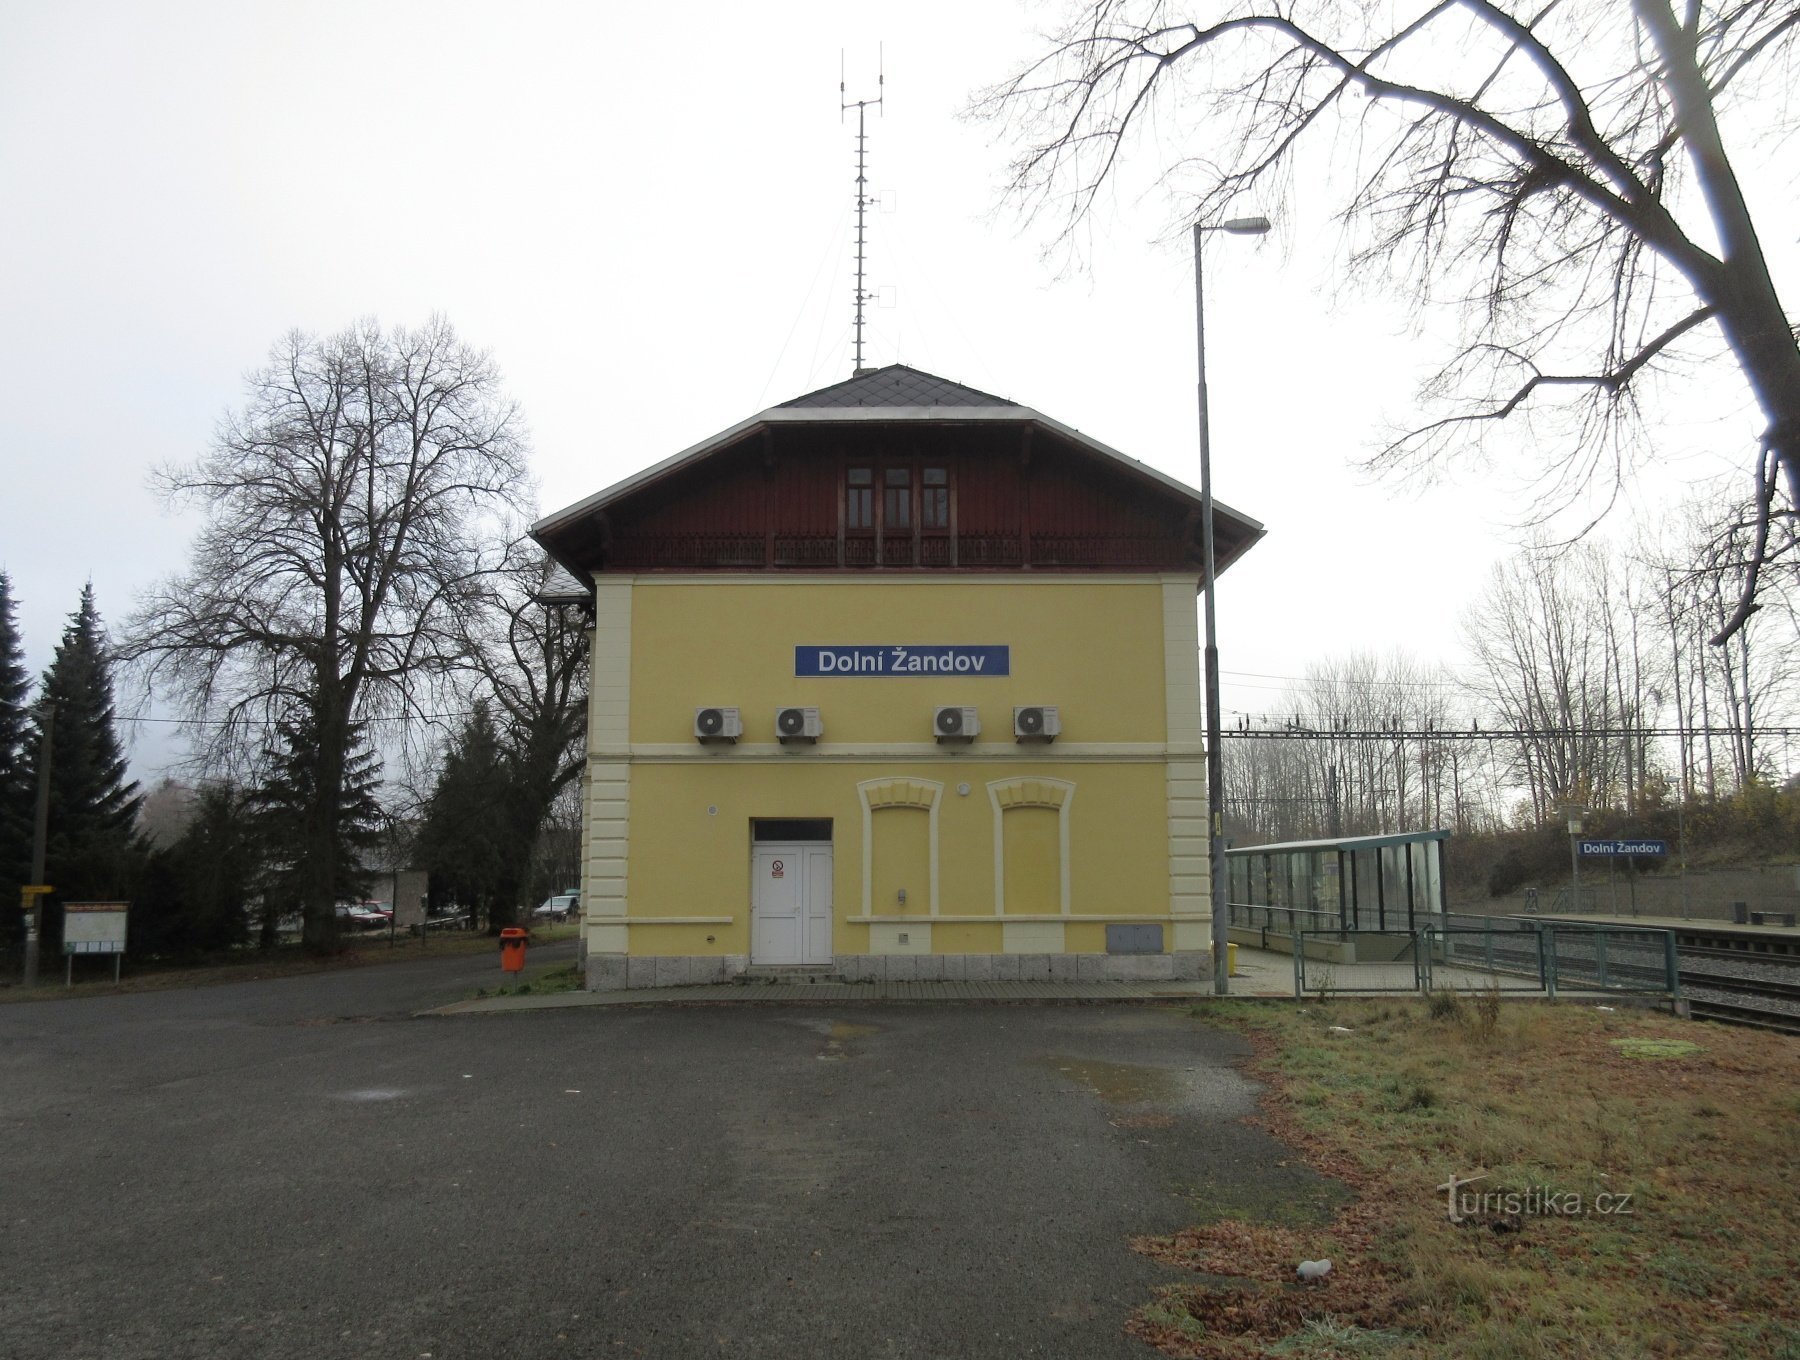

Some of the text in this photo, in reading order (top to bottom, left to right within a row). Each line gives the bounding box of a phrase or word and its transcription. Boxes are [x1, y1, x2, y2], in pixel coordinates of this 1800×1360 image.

[818, 646, 986, 672] Dolní Žandov
[1583, 840, 1660, 854] Dolní Žandov
